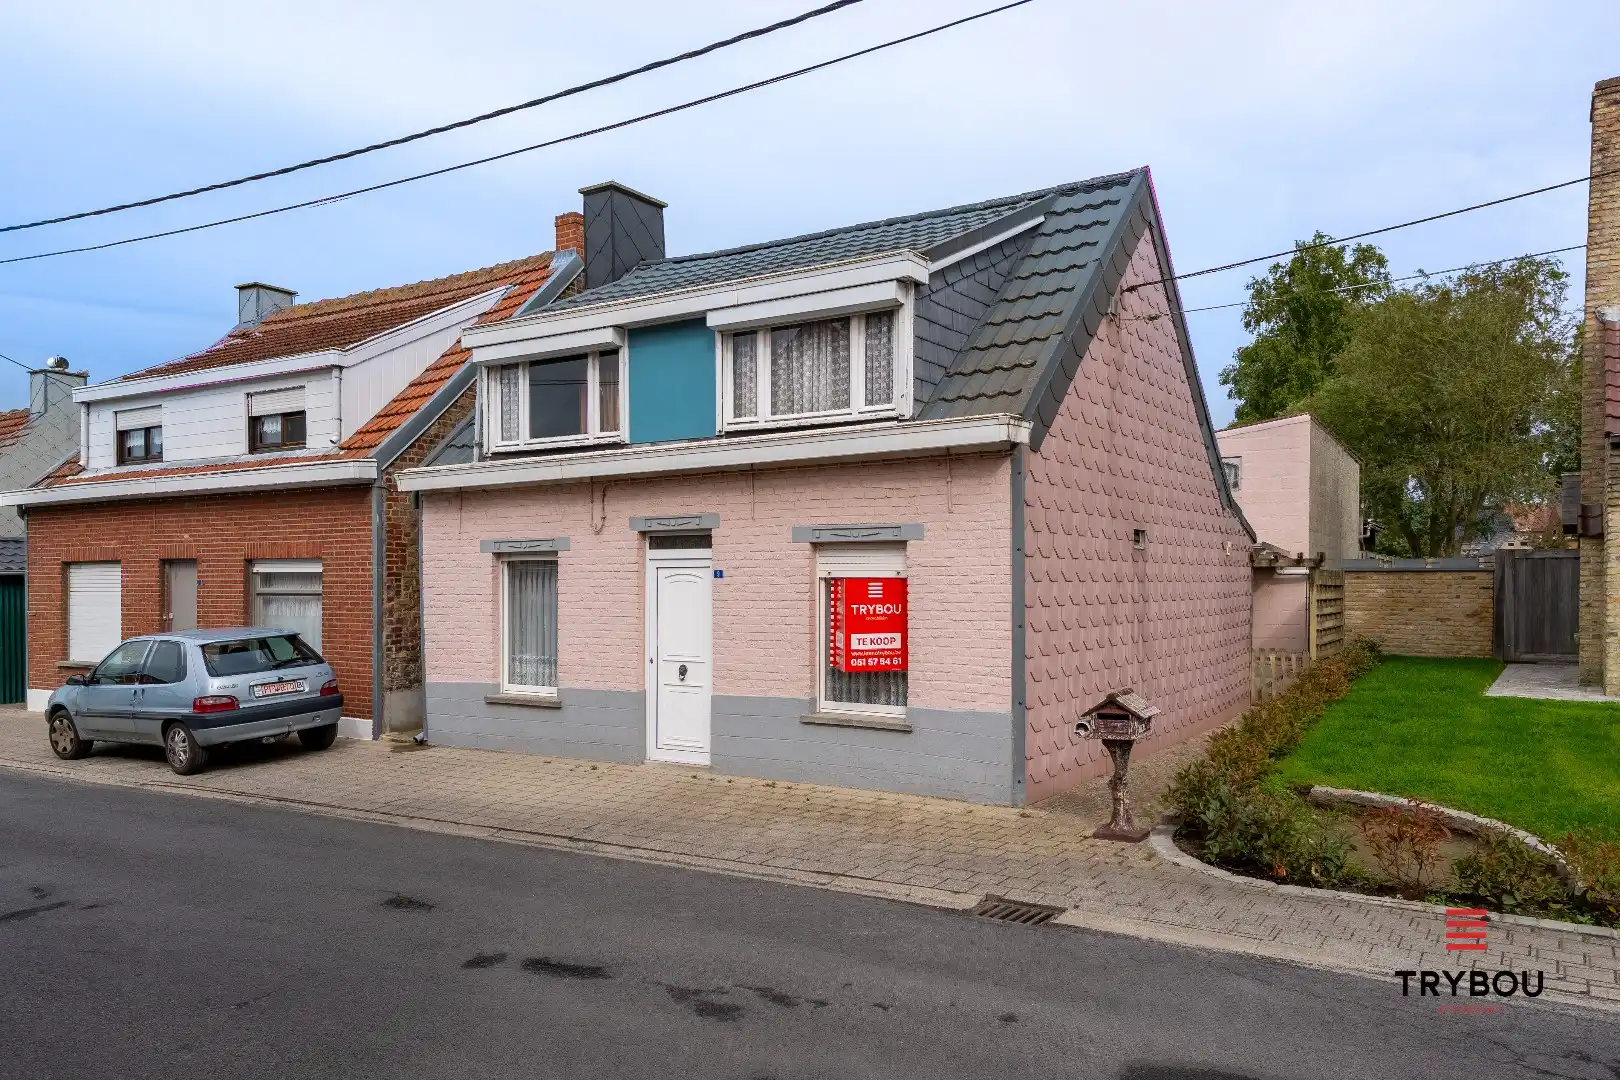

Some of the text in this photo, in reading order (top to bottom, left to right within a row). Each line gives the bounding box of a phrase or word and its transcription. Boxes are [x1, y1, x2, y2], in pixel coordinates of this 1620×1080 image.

[851, 604, 902, 615] TRYBOU
[856, 636, 896, 646] TE KOOP
[850, 658, 866, 666] 051
[868, 658, 878, 666] 57
[892, 656, 902, 664] 61
